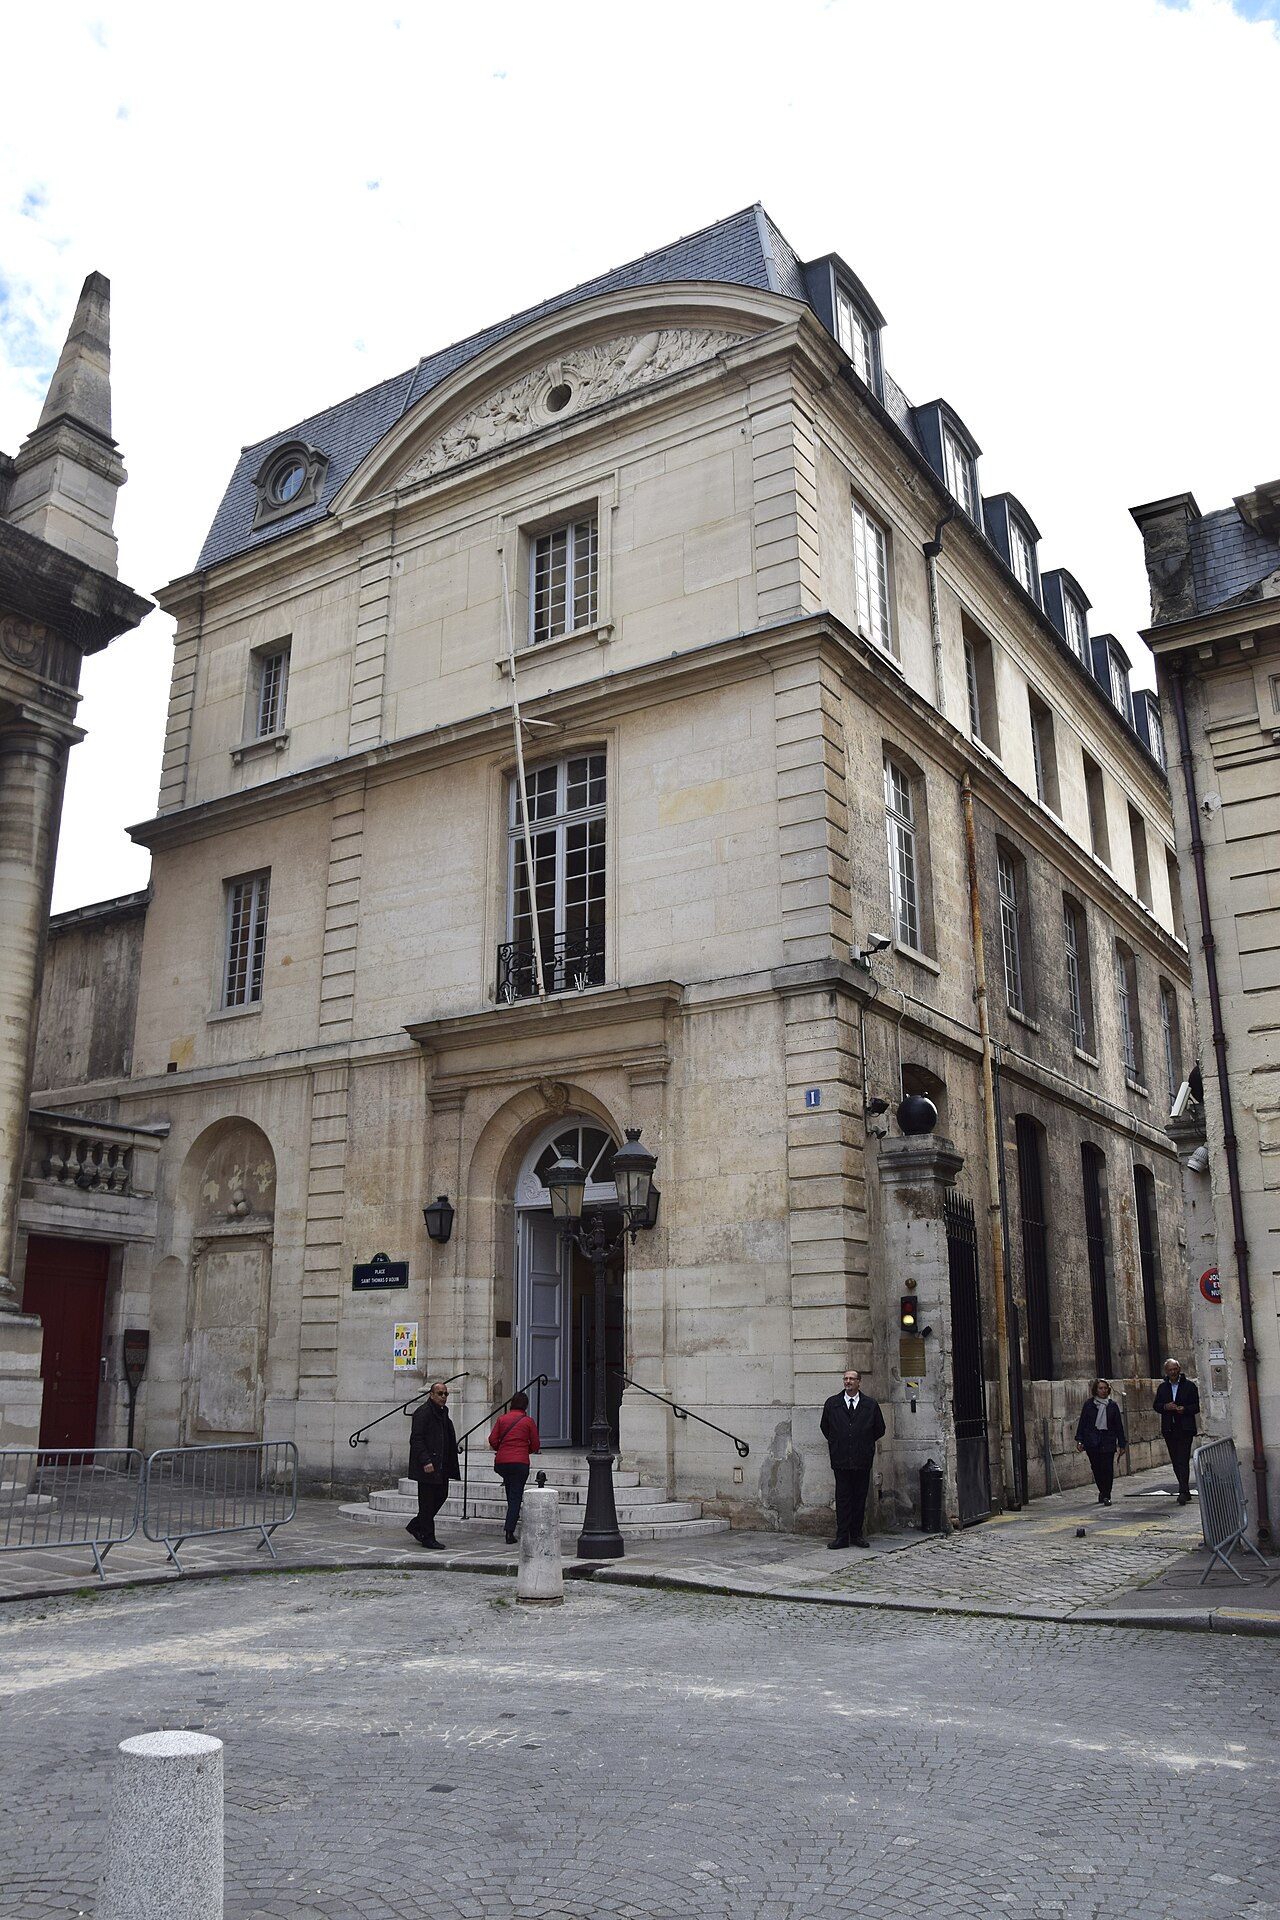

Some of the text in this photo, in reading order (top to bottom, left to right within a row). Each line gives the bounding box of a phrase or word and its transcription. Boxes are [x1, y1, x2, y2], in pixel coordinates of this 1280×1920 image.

[395, 1332, 410, 1340] PAT
[394, 1349, 412, 1357] MOI
[406, 1357, 416, 1366] NE
